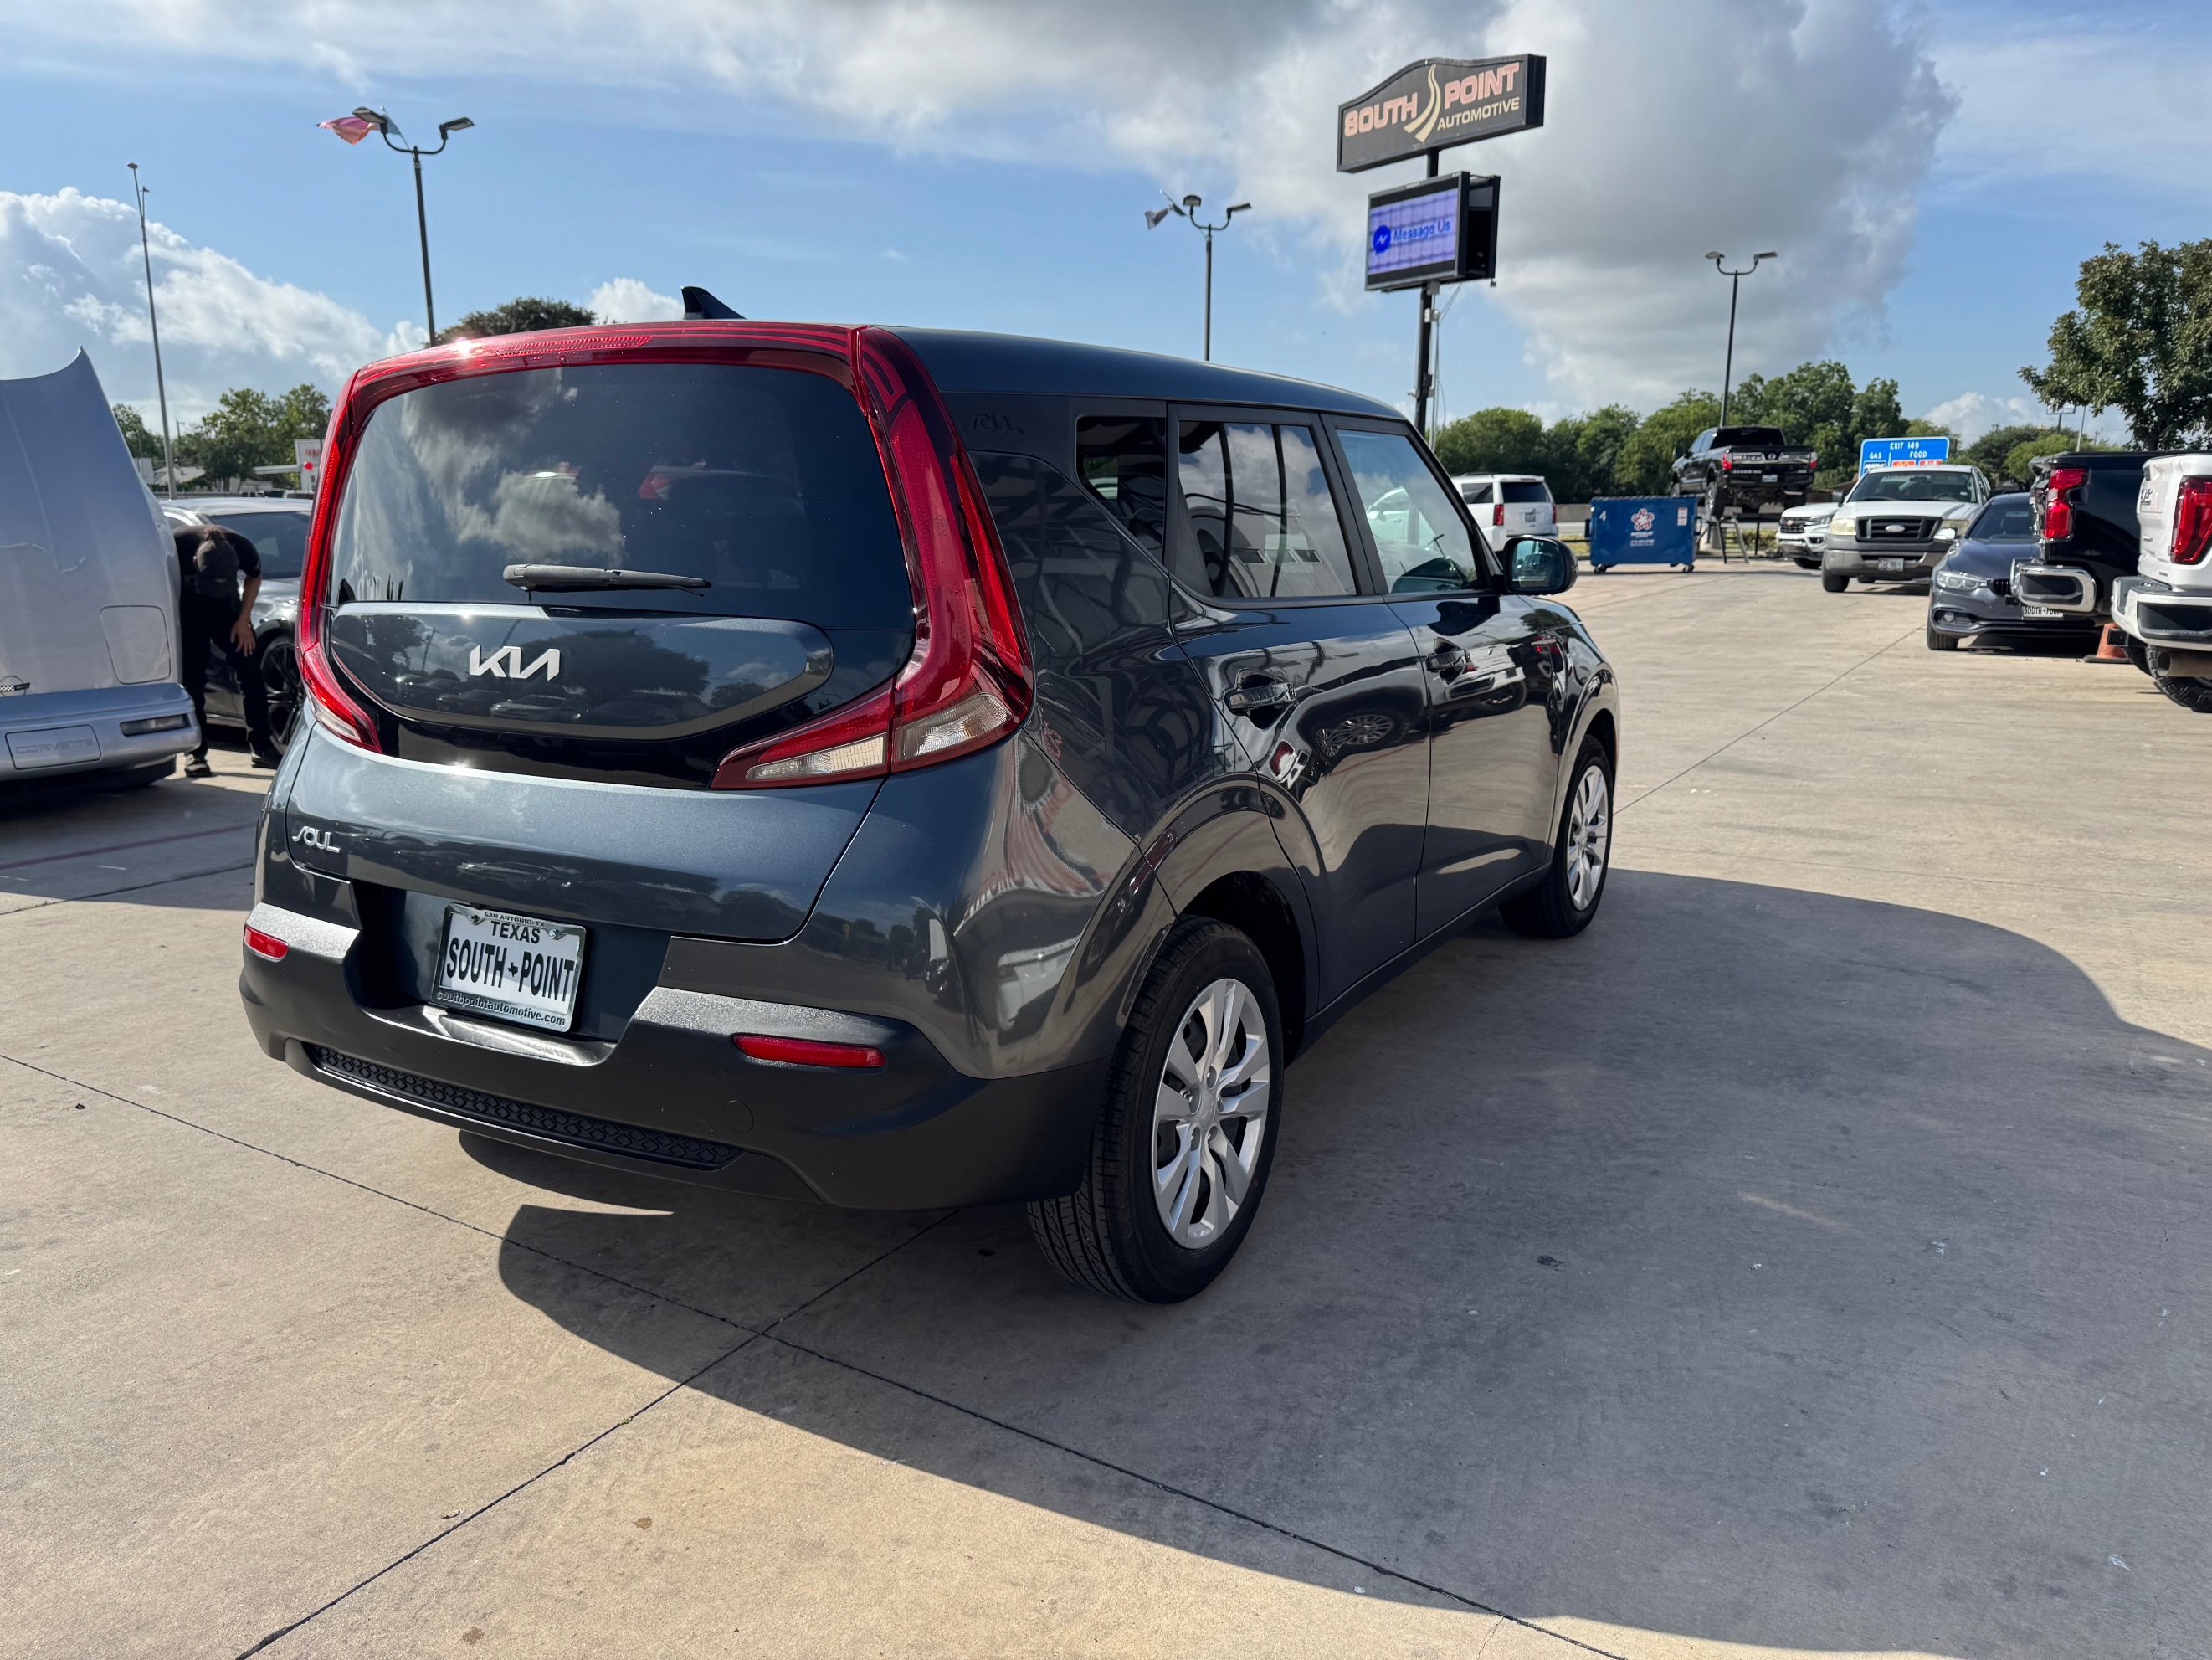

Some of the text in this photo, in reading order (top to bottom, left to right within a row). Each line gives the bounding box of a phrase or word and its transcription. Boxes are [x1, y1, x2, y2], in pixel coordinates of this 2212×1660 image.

[1344, 62, 1520, 137] SOUTH POINT
[1436, 96, 1520, 131] AUTOMOTIVE
[1393, 218, 1451, 243] Message Us
[1890, 441, 1920, 450] EXIT 149
[1909, 450, 1927, 459] FOOD
[1599, 510, 1607, 522] 4
[469, 644, 561, 681] KIA
[292, 825, 342, 853] SOUL
[484, 911, 499, 919] SAN
[490, 920, 541, 944] TEXAS
[446, 937, 576, 1002] SOUTH POINT
[436, 989, 566, 1026] southpointautomotive.com
